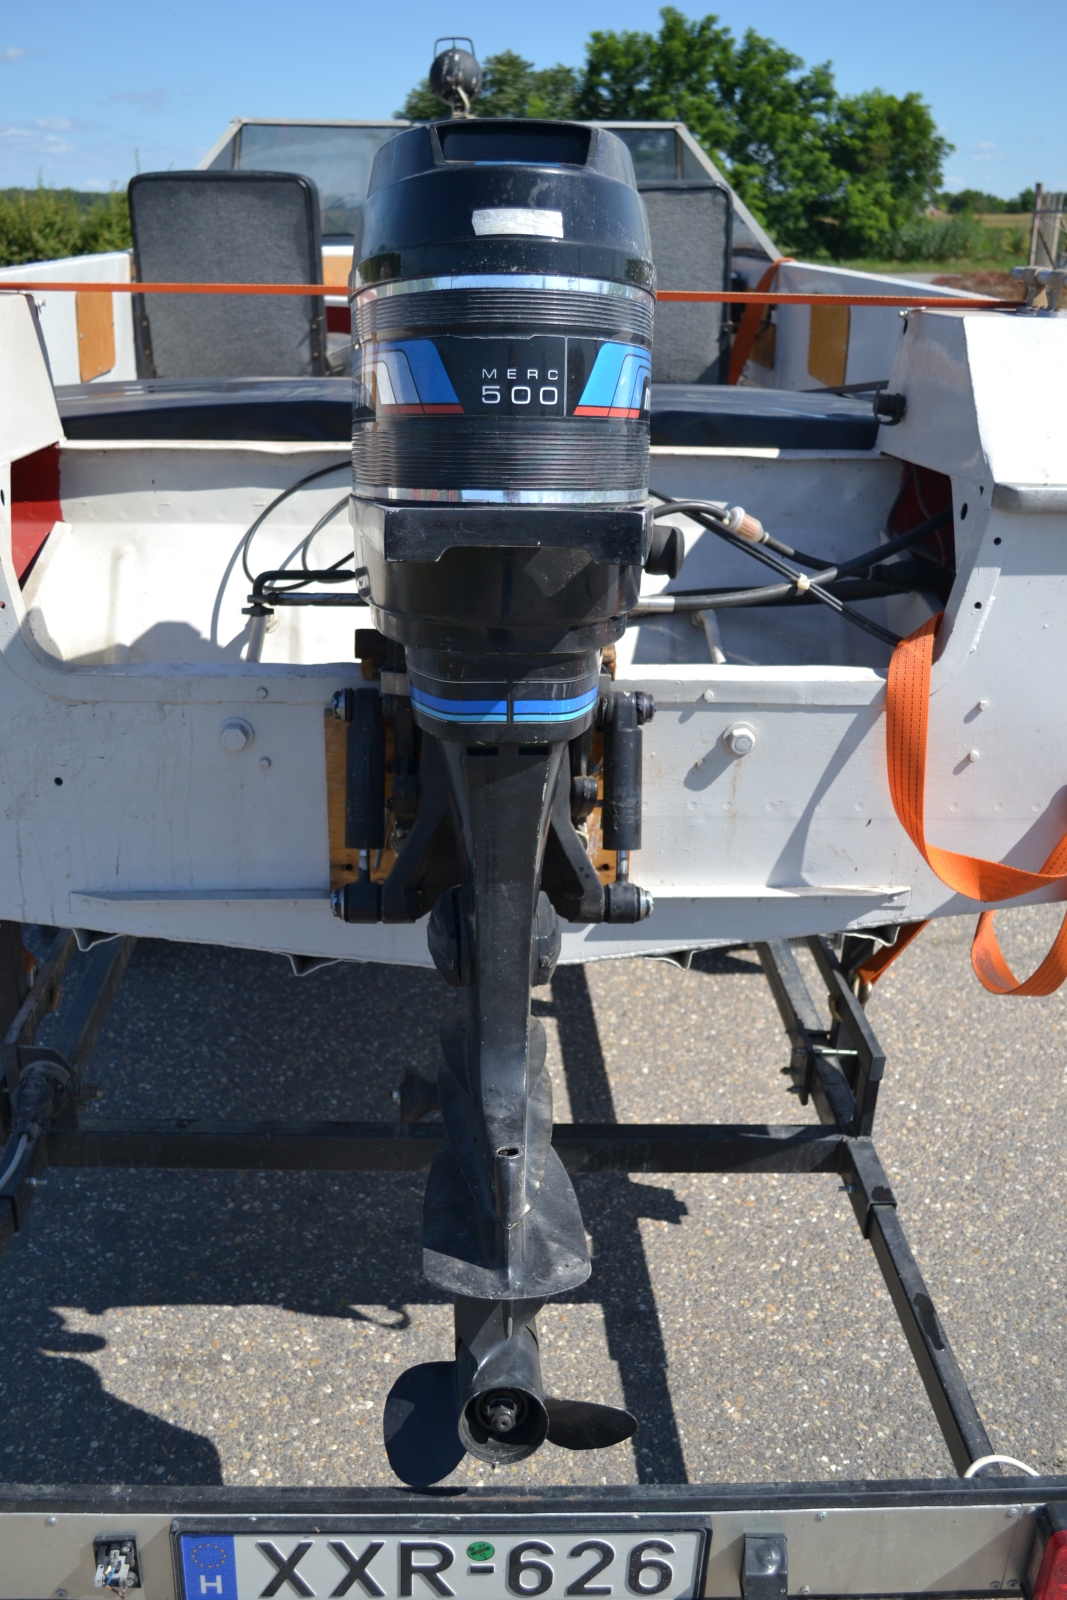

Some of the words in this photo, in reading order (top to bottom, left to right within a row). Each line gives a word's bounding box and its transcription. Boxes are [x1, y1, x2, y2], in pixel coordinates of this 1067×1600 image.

[482, 368, 559, 381] MERC
[481, 385, 558, 405] 500
[256, 1539, 675, 1598] XXR-626
[200, 1574, 223, 1594] H
